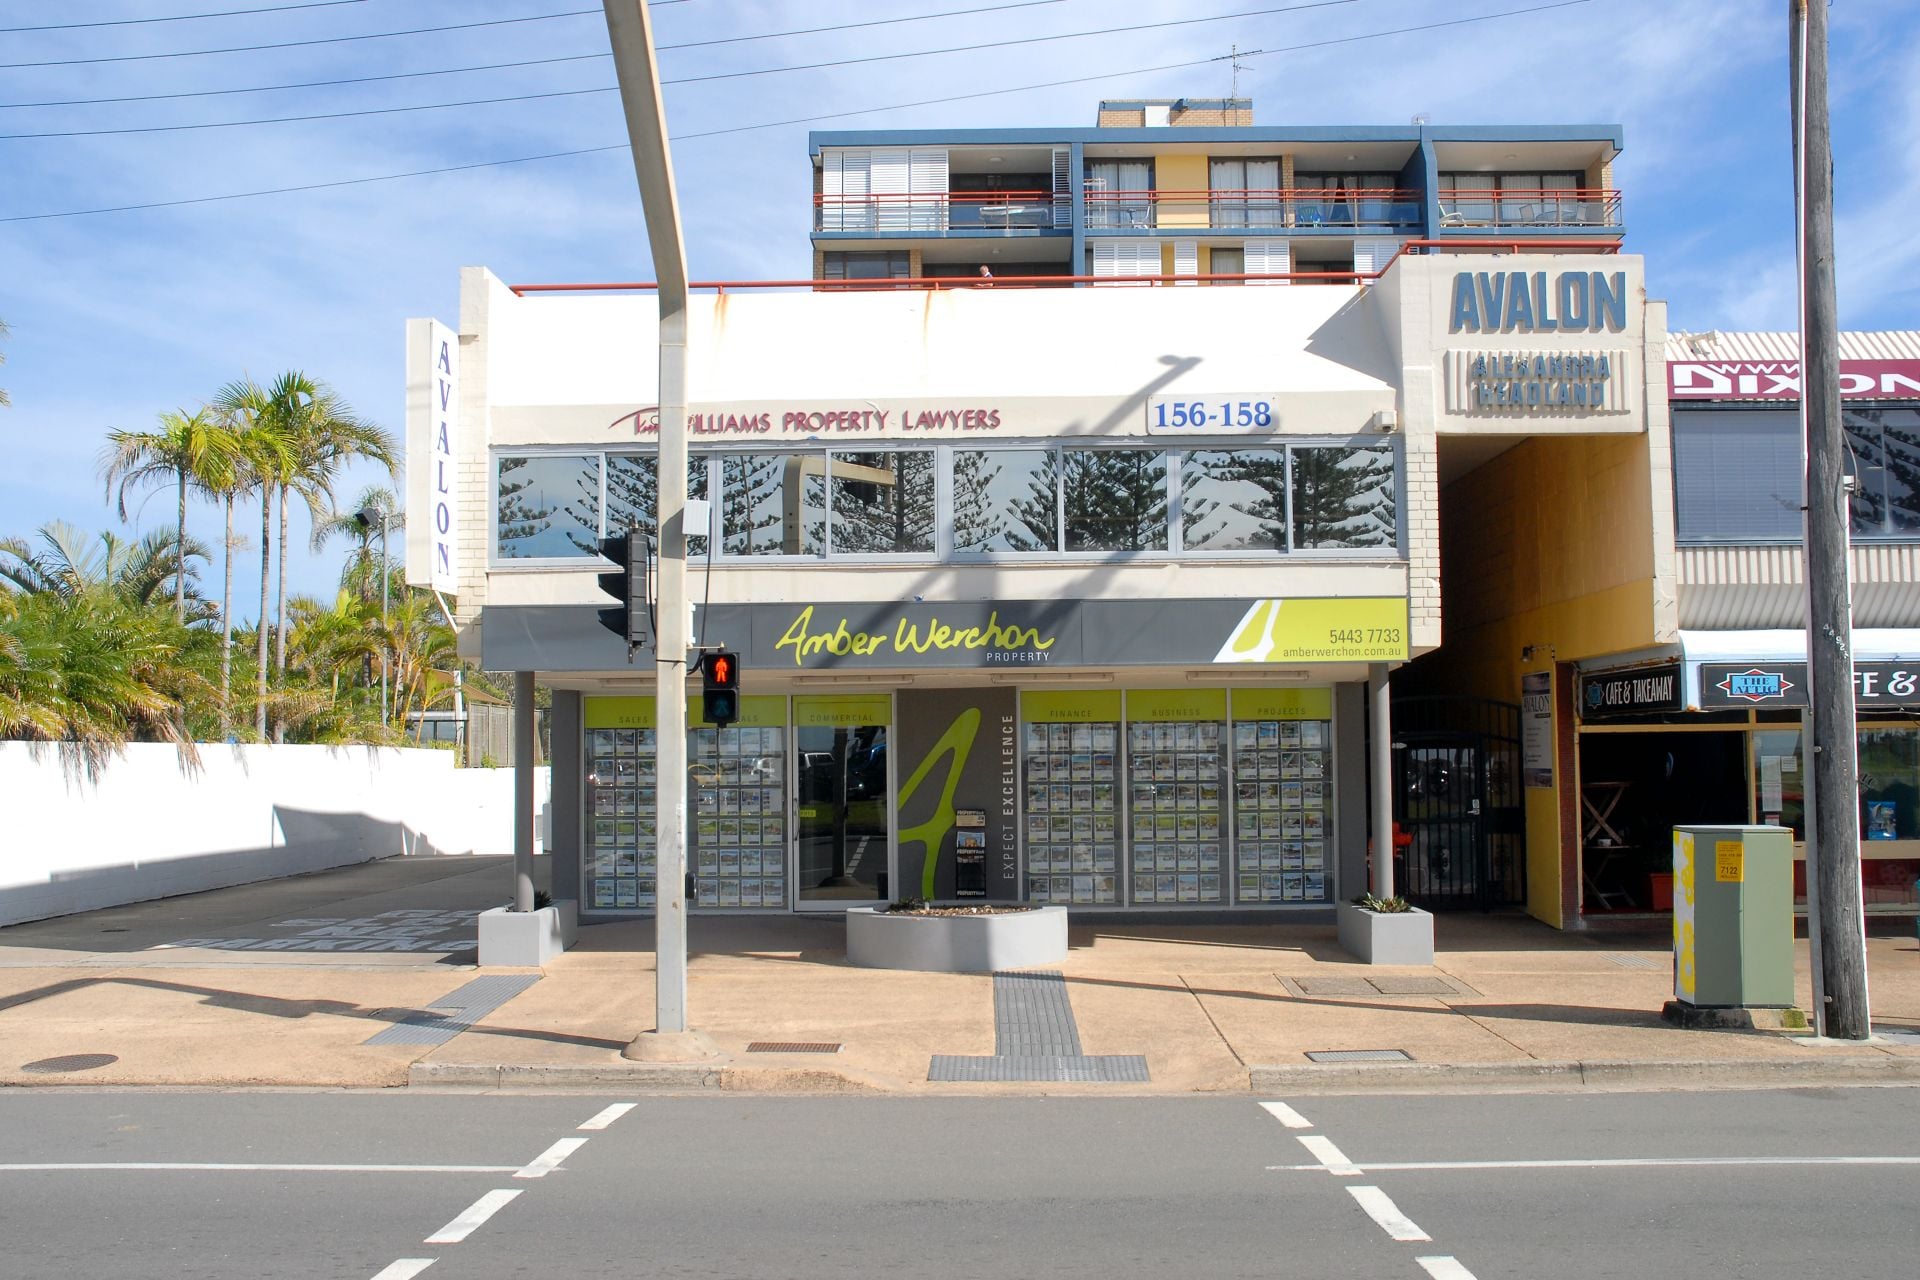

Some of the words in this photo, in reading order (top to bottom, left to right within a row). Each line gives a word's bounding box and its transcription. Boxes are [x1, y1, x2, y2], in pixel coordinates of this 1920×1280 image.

[1450, 271, 1626, 332] AVALON
[687, 413, 771, 434] ILLIAMS
[783, 410, 889, 432] PROPERTY
[902, 408, 1001, 431] LAWYERS
[1154, 402, 1272, 428] 156-158
[437, 340, 452, 575] AVALON
[776, 605, 887, 666] Amber
[895, 611, 1055, 653] Werchon
[1330, 629, 1363, 644] 5443
[1367, 628, 1400, 643] 7733
[986, 652, 1050, 662] PROPERTY
[1283, 646, 1401, 658] amberwerchon.com.au
[1740, 677, 1770, 685] THE
[1605, 682, 1623, 705] CAFE
[1623, 680, 1631, 704] &
[1633, 675, 1673, 703] TAKEAWAY
[1734, 686, 1777, 695] ATTIC
[1050, 710, 1093, 718] FINANCE
[1152, 708, 1201, 717] BUSINESS
[1257, 707, 1307, 716] PROJECTS
[618, 716, 648, 724] SALES
[810, 714, 874, 722] COMMERCIAL
[1002, 715, 1014, 816] EXCELLENCE
[1003, 824, 1015, 879] EXPECT
[1720, 866, 1739, 875] 7122
